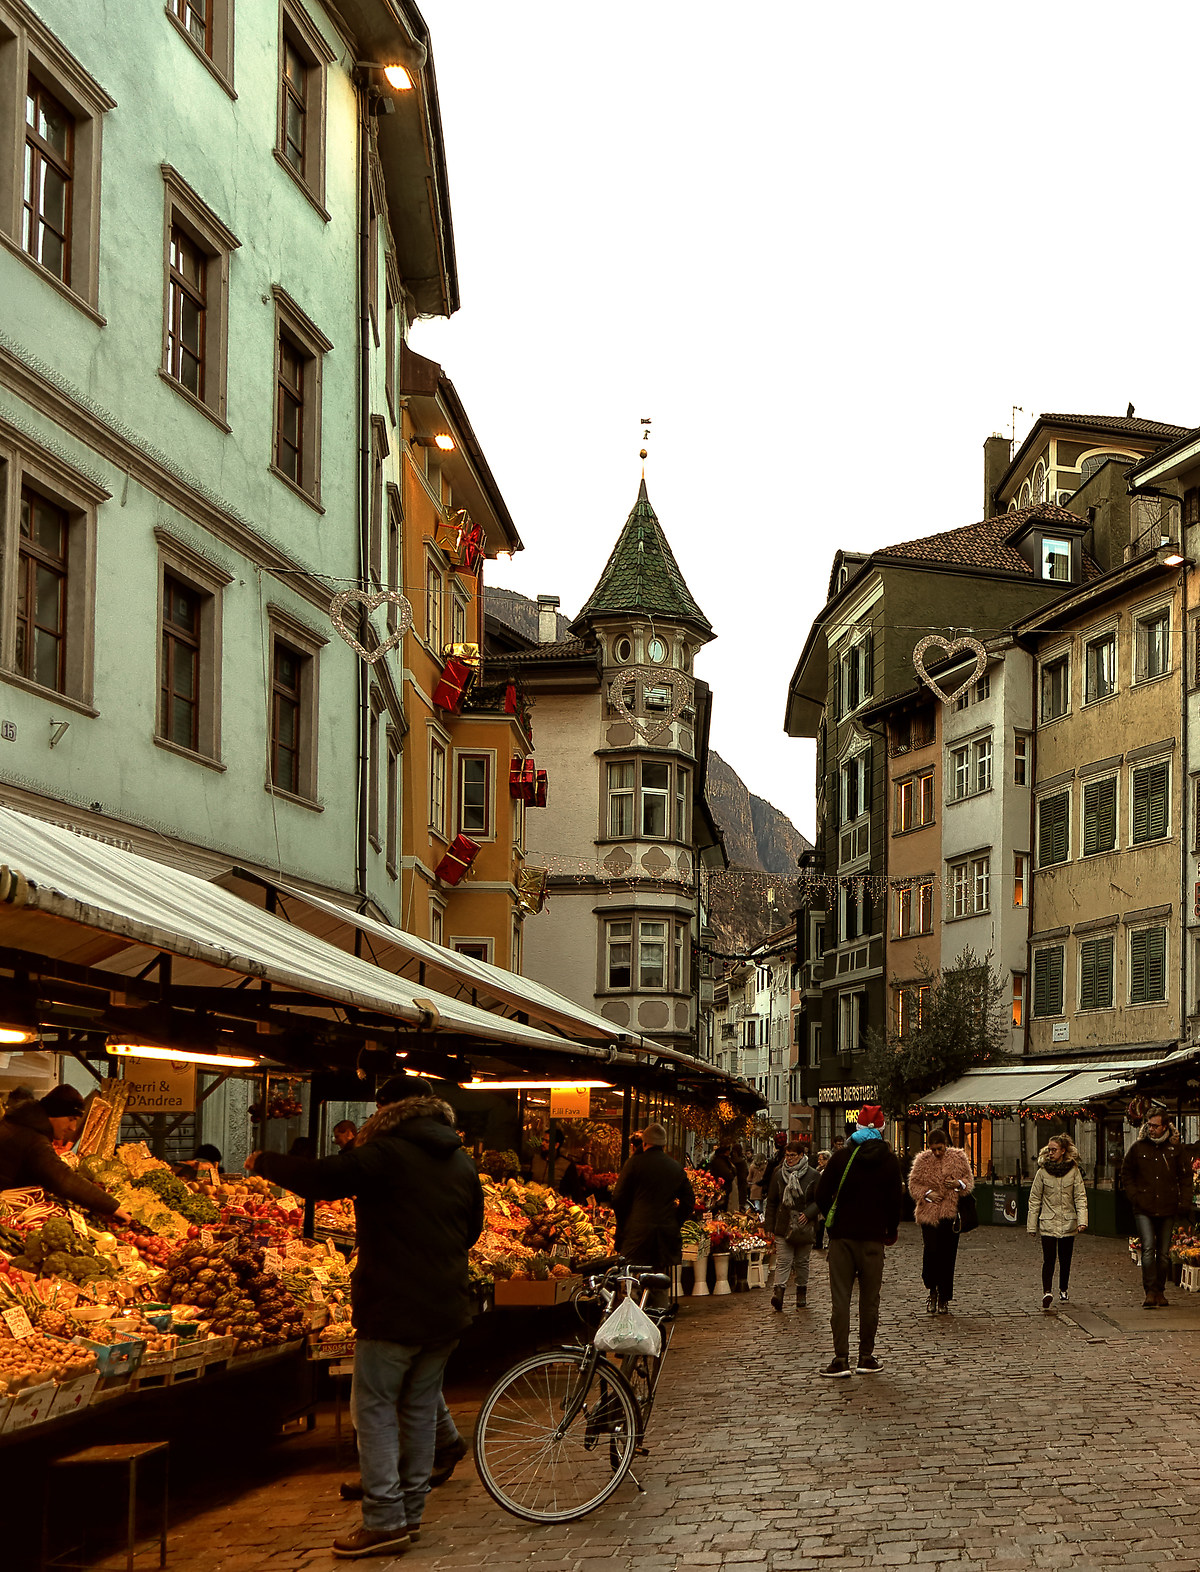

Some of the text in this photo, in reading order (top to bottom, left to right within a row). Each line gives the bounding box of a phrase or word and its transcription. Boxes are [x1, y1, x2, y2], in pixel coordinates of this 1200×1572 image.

[4, 722, 14, 739] 15
[159, 1080, 170, 1092] &
[818, 1084, 879, 1103] BIRRERIA BIERSTUBEN
[127, 1094, 183, 1107] D'Andrea
[565, 1107, 580, 1115] Fava
